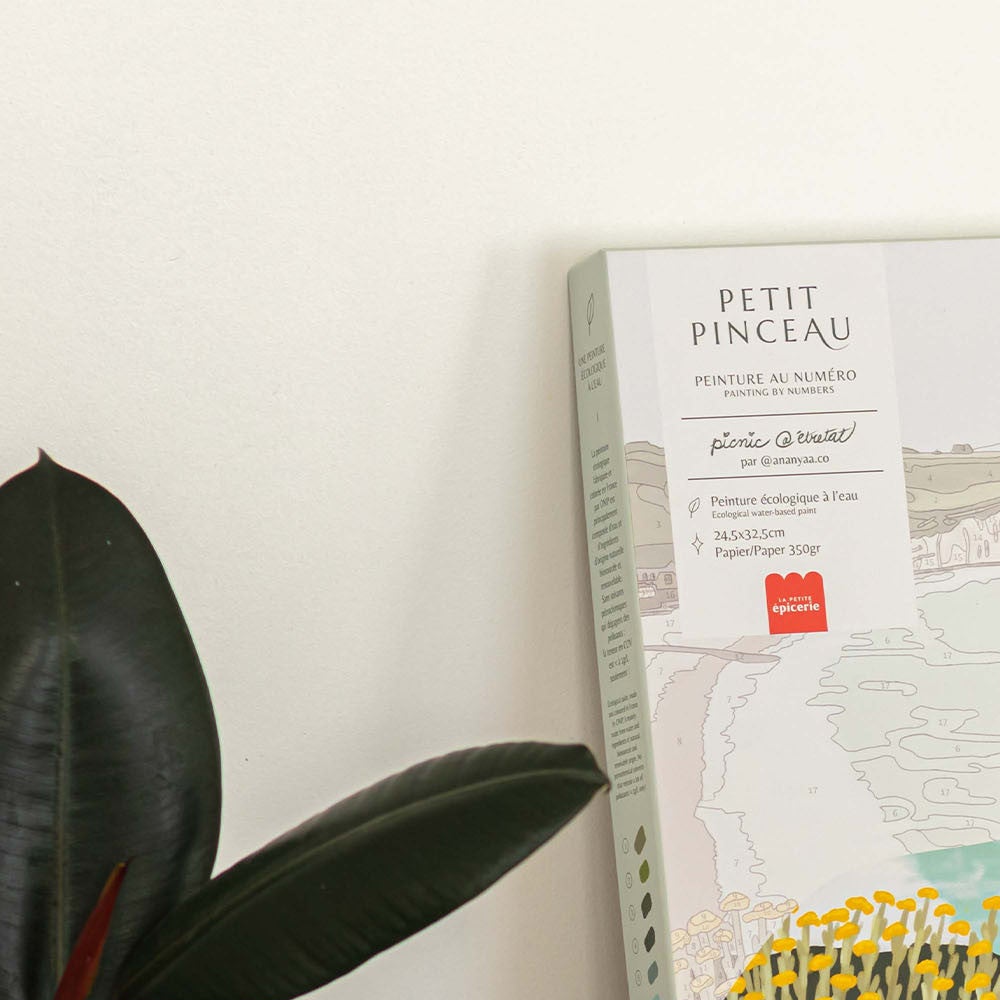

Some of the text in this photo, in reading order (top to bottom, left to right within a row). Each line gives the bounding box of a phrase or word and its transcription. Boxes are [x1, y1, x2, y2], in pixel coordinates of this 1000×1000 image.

[719, 286, 818, 313] PETIT
[691, 316, 851, 351] PINCEAU
[695, 367, 857, 388] PEINTURE AU NUMÉRO
[724, 385, 835, 398] PAINTING BY NUMBERS
[710, 431, 770, 456] picnic
[740, 454, 830, 469] par @ananyaa.co
[711, 489, 858, 507] Peinture écologique à l'eau
[712, 506, 817, 520] Ecological water-based paint
[714, 527, 785, 542] 24,5x32,5cm
[715, 543, 822, 558] Papier/Paper 350gr
[772, 601, 820, 616] épicerie
